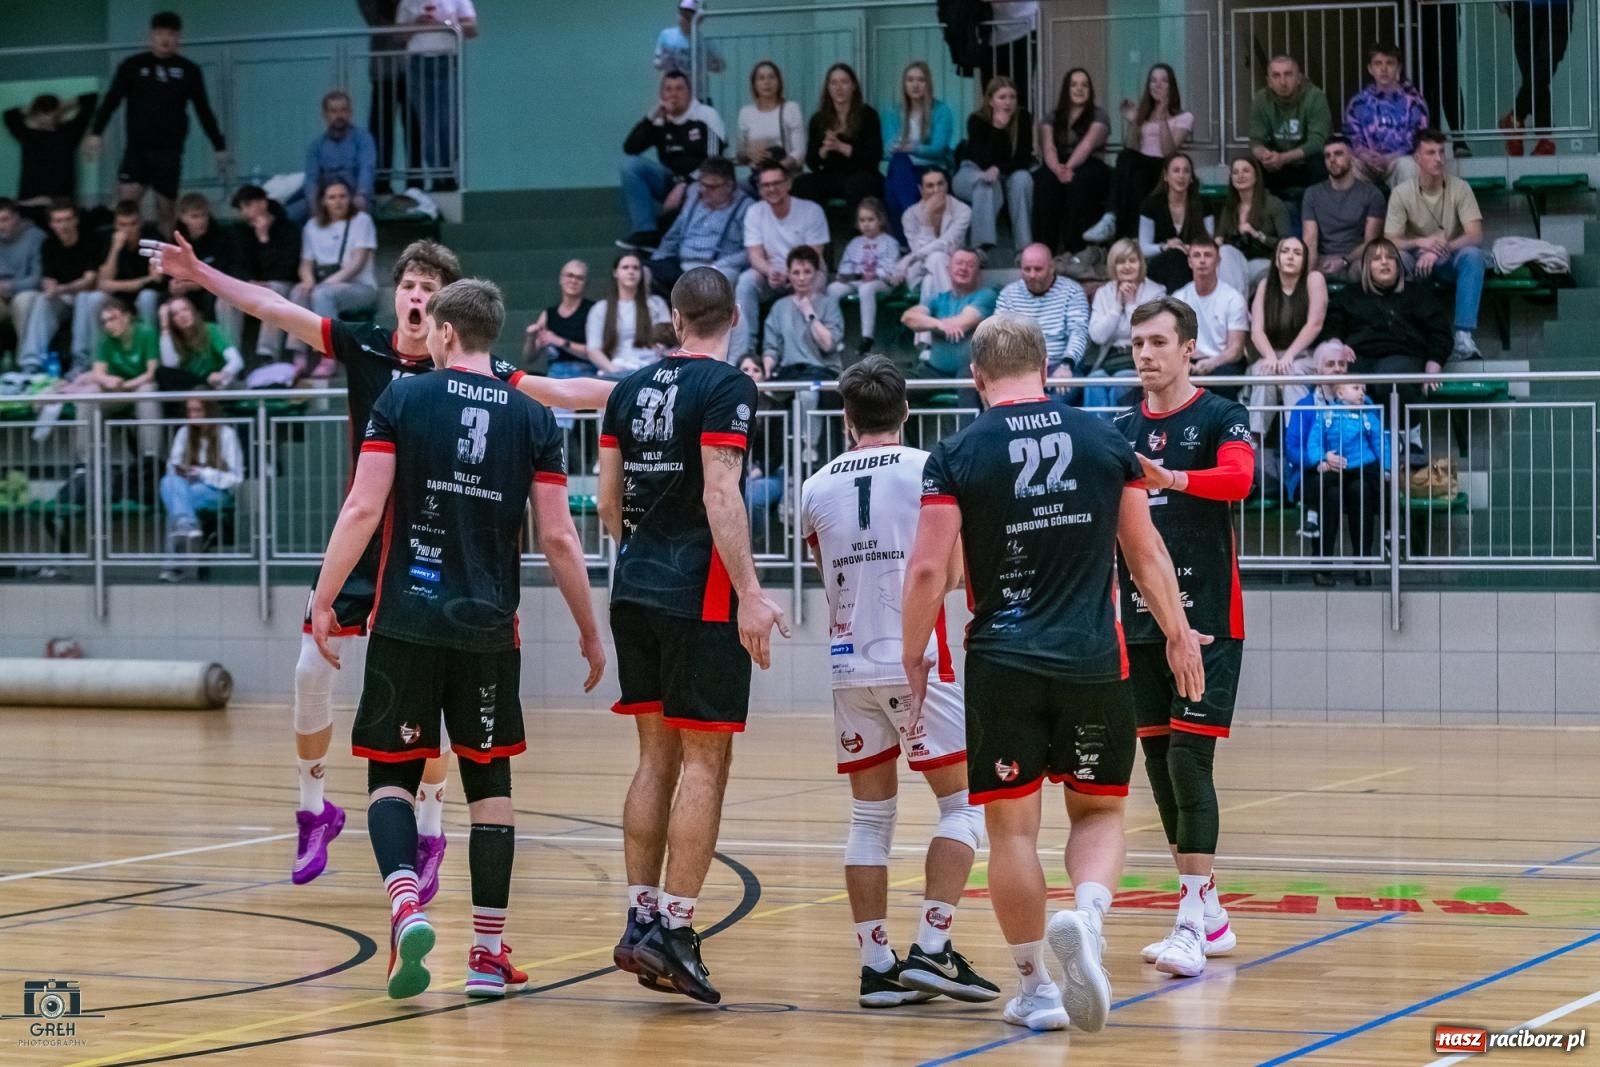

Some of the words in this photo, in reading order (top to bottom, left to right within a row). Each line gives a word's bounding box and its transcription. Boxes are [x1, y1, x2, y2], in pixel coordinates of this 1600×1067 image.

[447, 379, 508, 405] DEMCIO
[631, 384, 679, 442] 31
[1005, 411, 1062, 432] WIKŁO
[456, 407, 490, 465] 3
[830, 453, 901, 475] DZIUBEK
[1008, 431, 1077, 499] 22
[453, 471, 482, 484] VOLLEY
[426, 479, 464, 494] DĄBROWA
[464, 483, 503, 502] GÓRNICZA
[854, 475, 873, 531] 1
[1032, 503, 1064, 516] VOLLEY
[1005, 519, 1049, 535] DĄBROWA
[1050, 513, 1092, 527] GÓRNICZA
[851, 540, 878, 551] VOLLEY
[865, 550, 905, 562] GÓRNICZA
